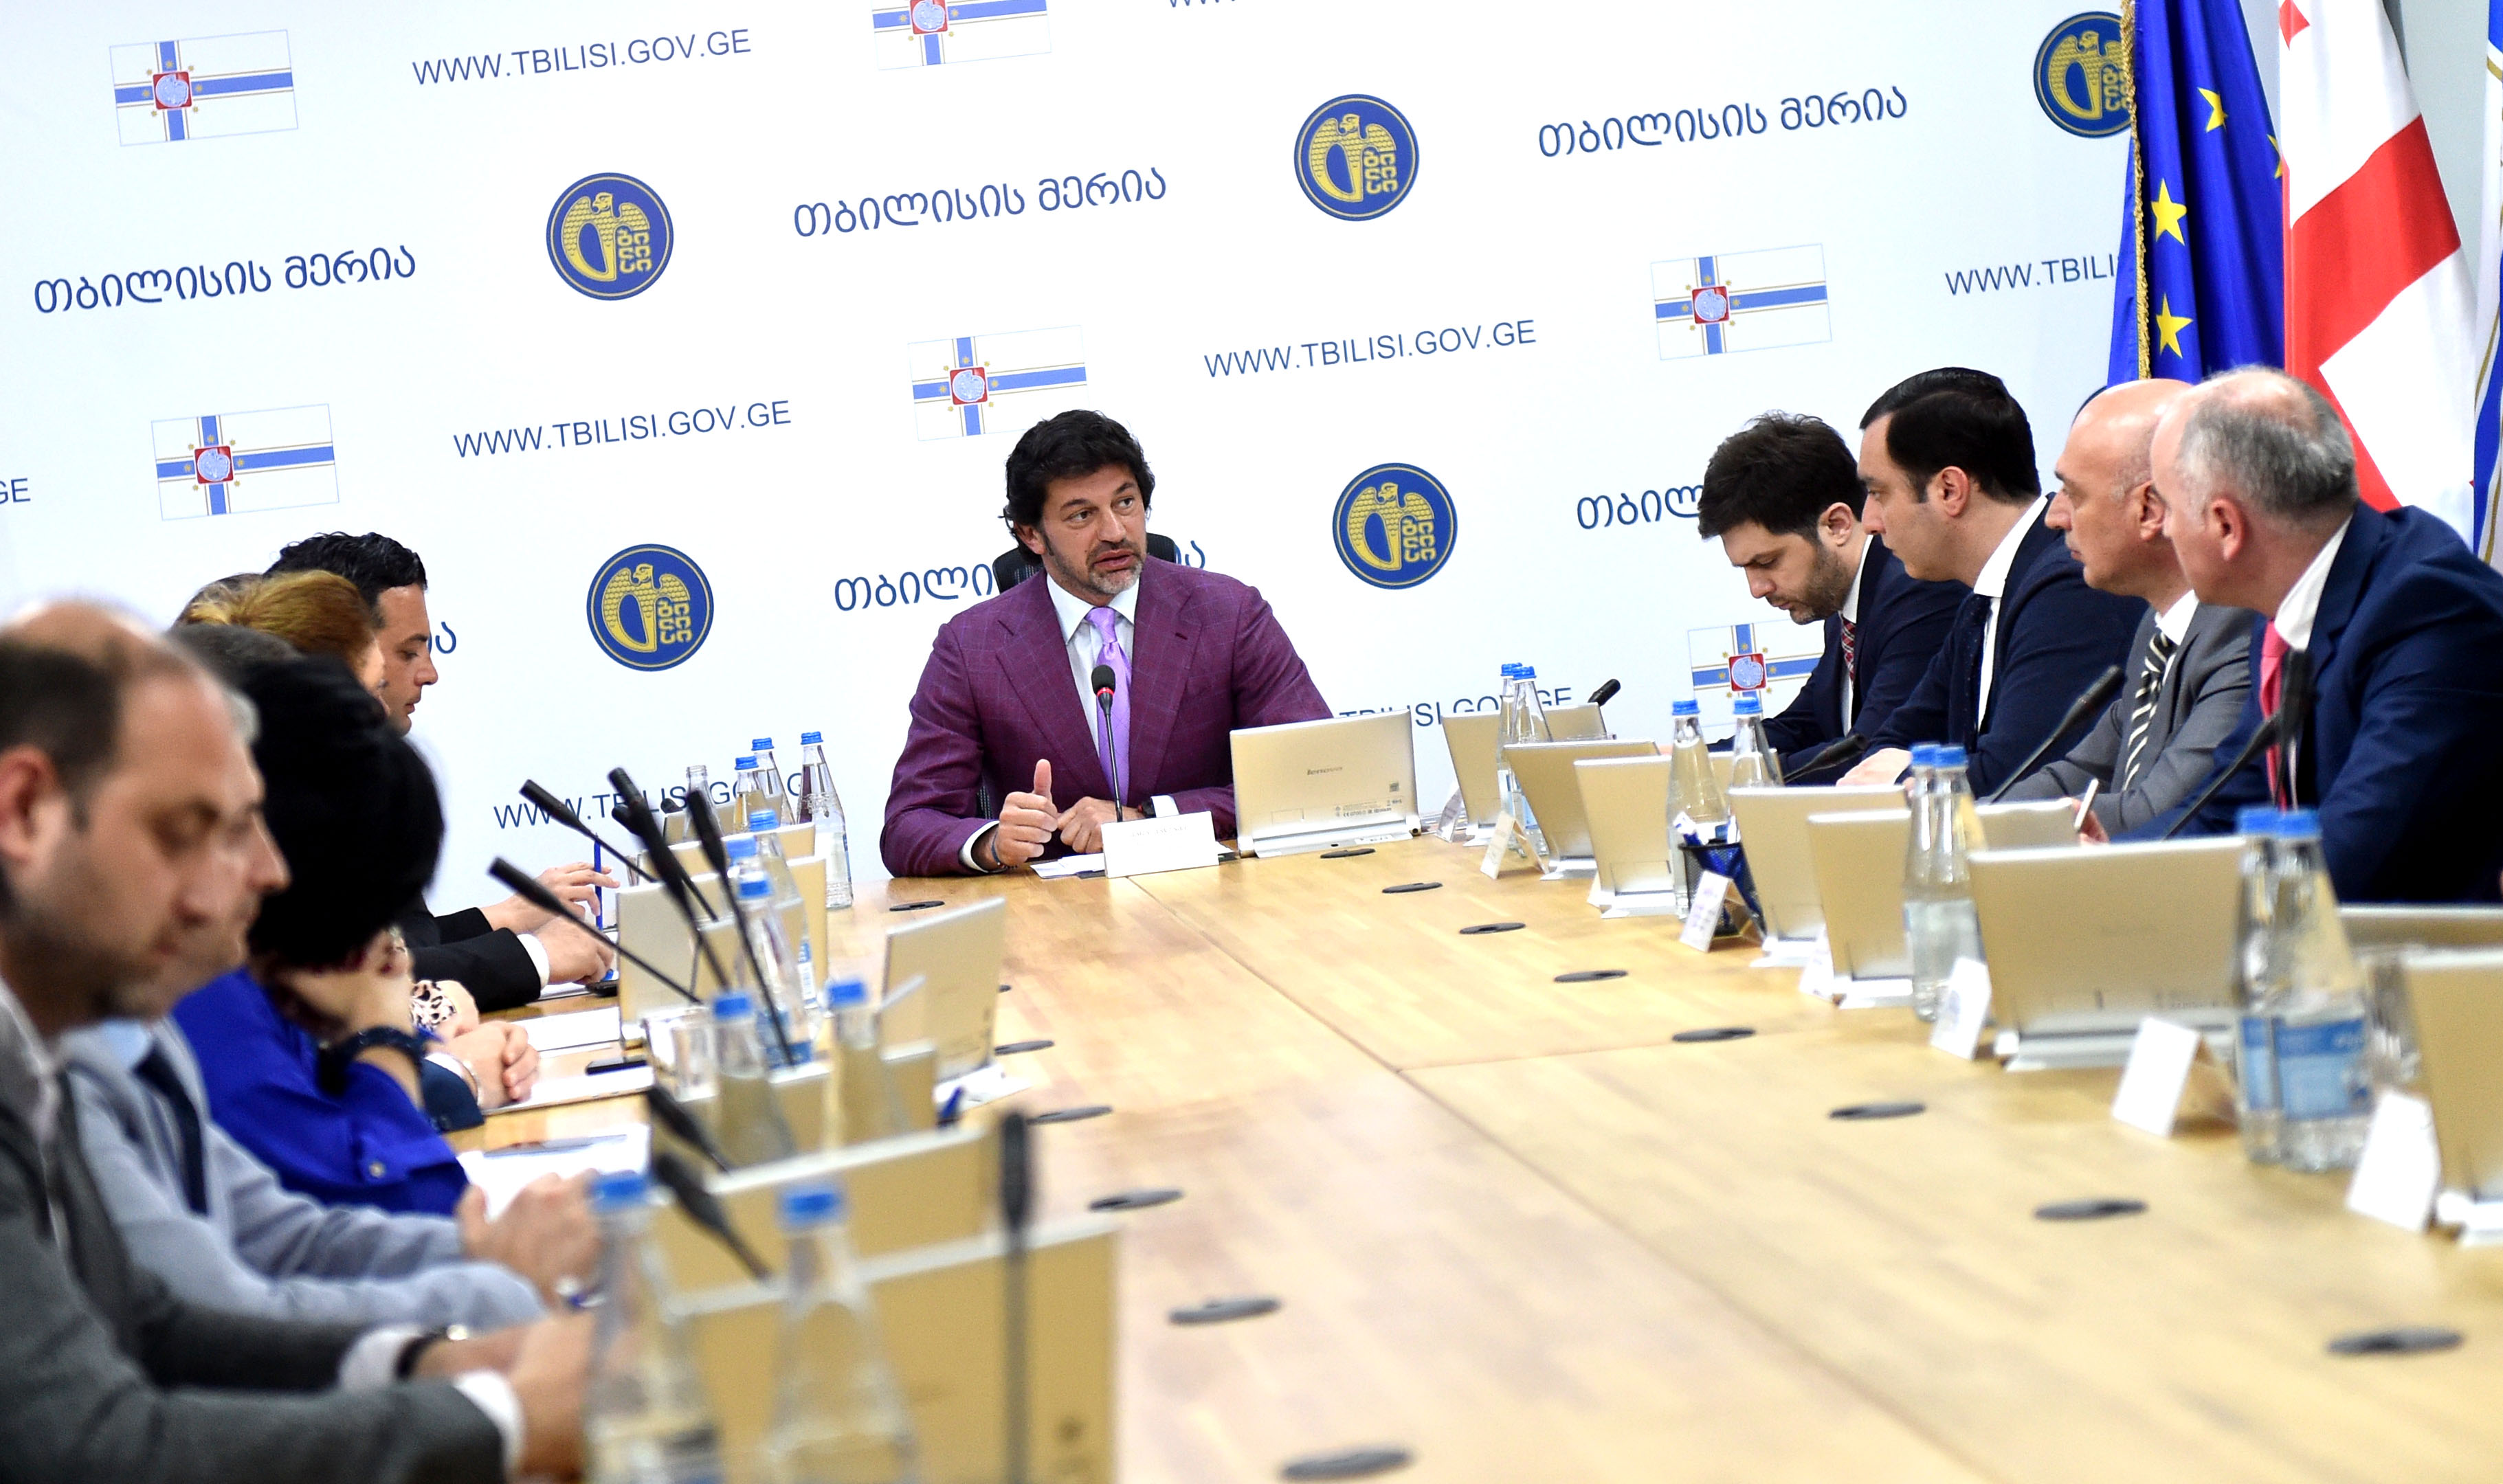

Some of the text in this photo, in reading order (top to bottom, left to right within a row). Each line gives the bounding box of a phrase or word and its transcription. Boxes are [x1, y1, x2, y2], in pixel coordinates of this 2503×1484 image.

[412, 29, 751, 85] WWW.TBILISI.GOV.GE
[1539, 86, 1907, 157] თბილისის მერია
[794, 167, 1166, 237] თბილისის მერია
[34, 245, 416, 313] თბილისის მერია
[1203, 319, 1536, 378] WWW.TBILISI.GOV.GE
[453, 400, 791, 458] WWW.TBILISI.GOV.GE
